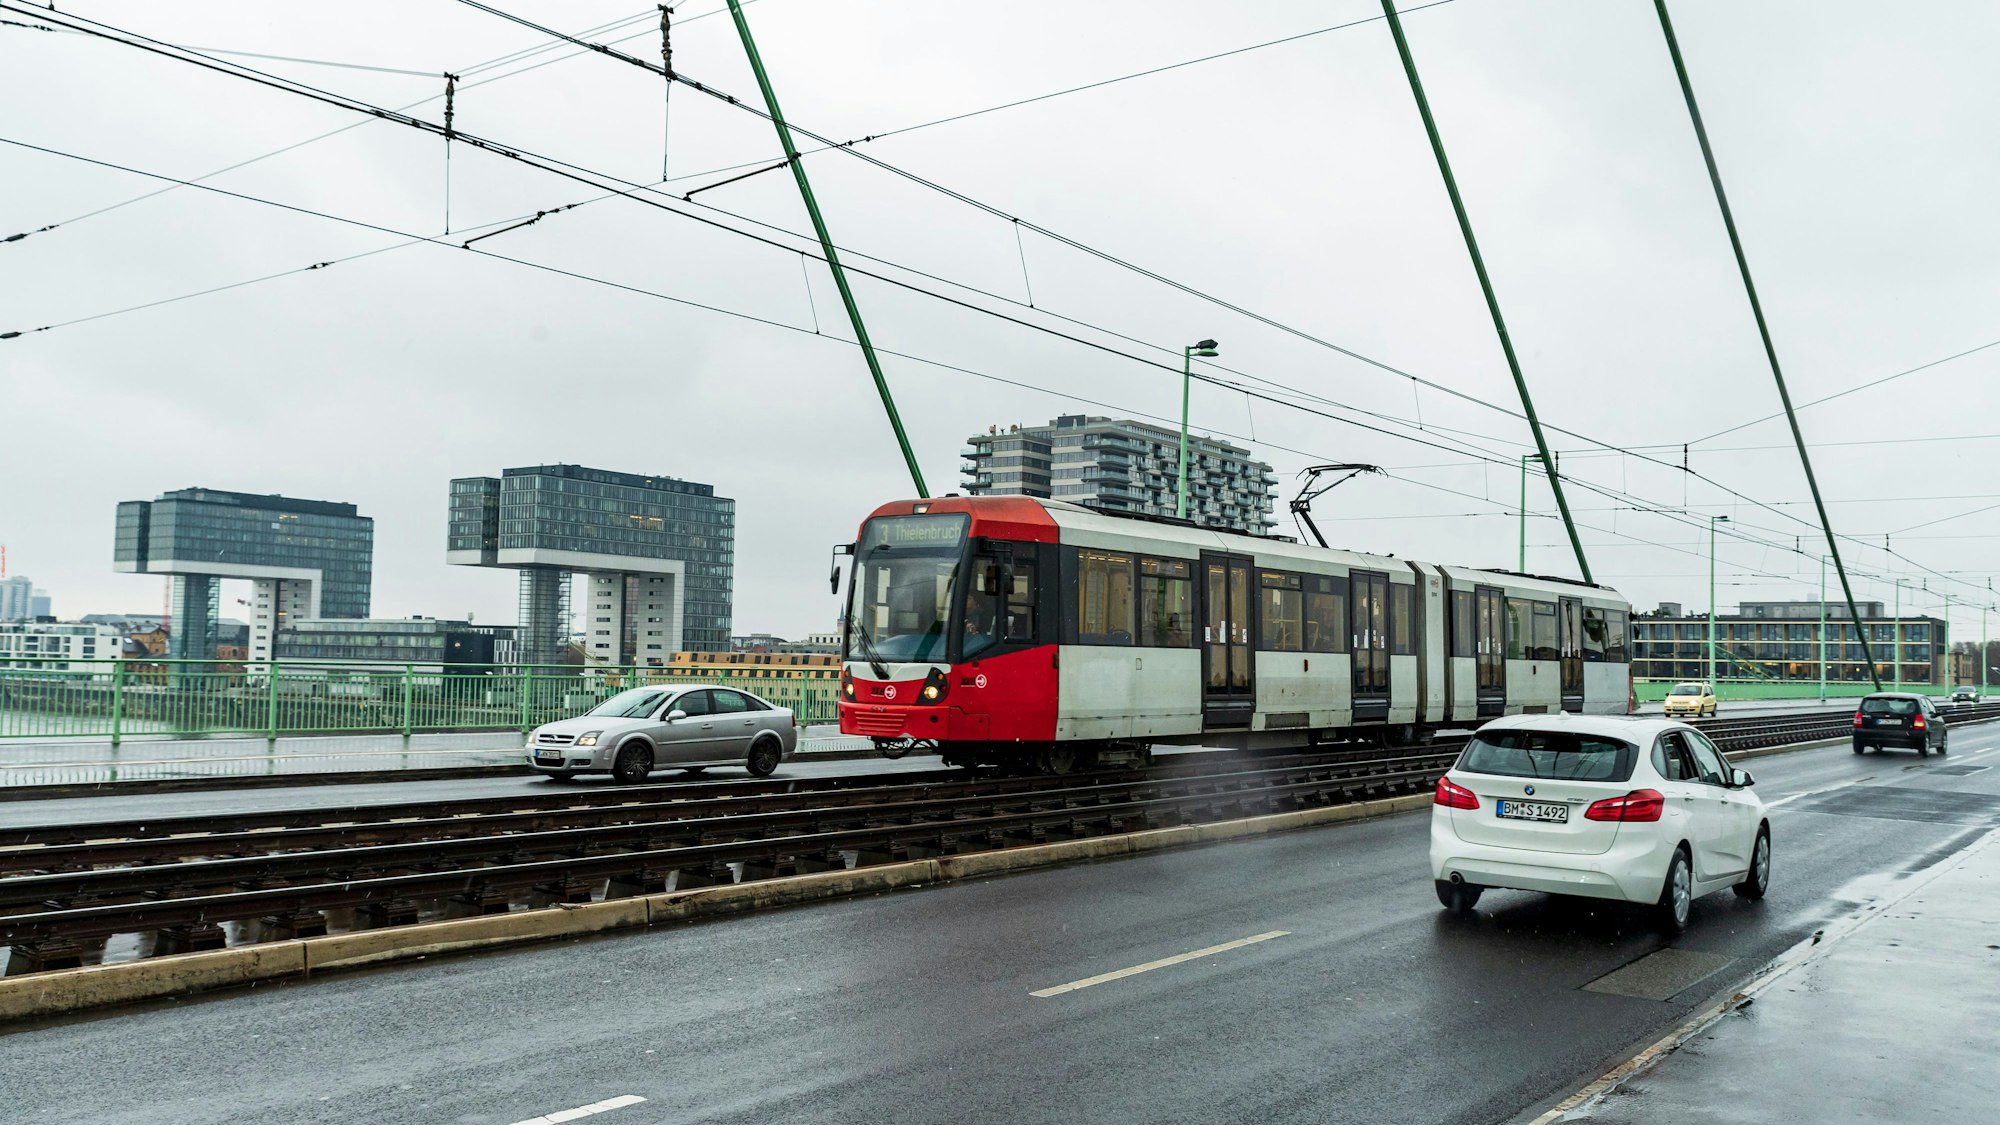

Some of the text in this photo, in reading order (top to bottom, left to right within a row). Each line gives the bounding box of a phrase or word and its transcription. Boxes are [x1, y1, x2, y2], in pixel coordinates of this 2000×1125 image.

[881, 521, 962, 544] 3 Thielenbruch
[1504, 802, 1519, 815] BM
[1536, 805, 1566, 819] 1492
